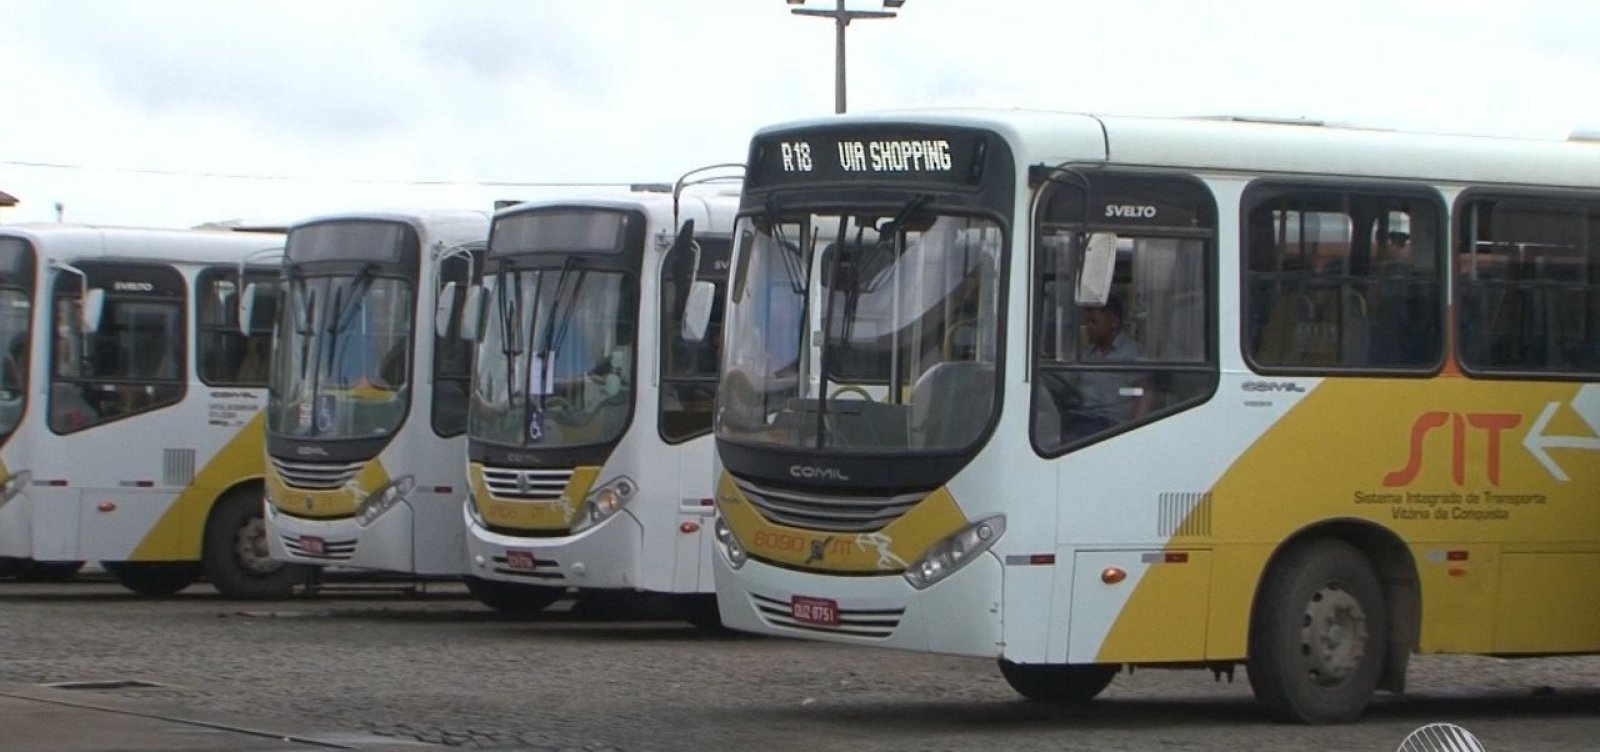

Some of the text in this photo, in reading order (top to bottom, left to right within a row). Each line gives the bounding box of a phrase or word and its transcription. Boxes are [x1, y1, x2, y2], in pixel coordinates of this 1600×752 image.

[838, 141, 867, 171] VIA
[869, 140, 952, 171] SHOPPING
[1105, 205, 1156, 218] SVELTO
[114, 281, 154, 291] SVELTO
[1241, 381, 1306, 393] COMIL
[1382, 411, 1523, 487] SIT
[789, 465, 849, 481] COMIL
[1354, 490, 1546, 507] Sistema Integrado de Transporte
[1391, 506, 1431, 520] Vitória
[1452, 506, 1509, 522] Conquista
[753, 531, 805, 552] 8090
